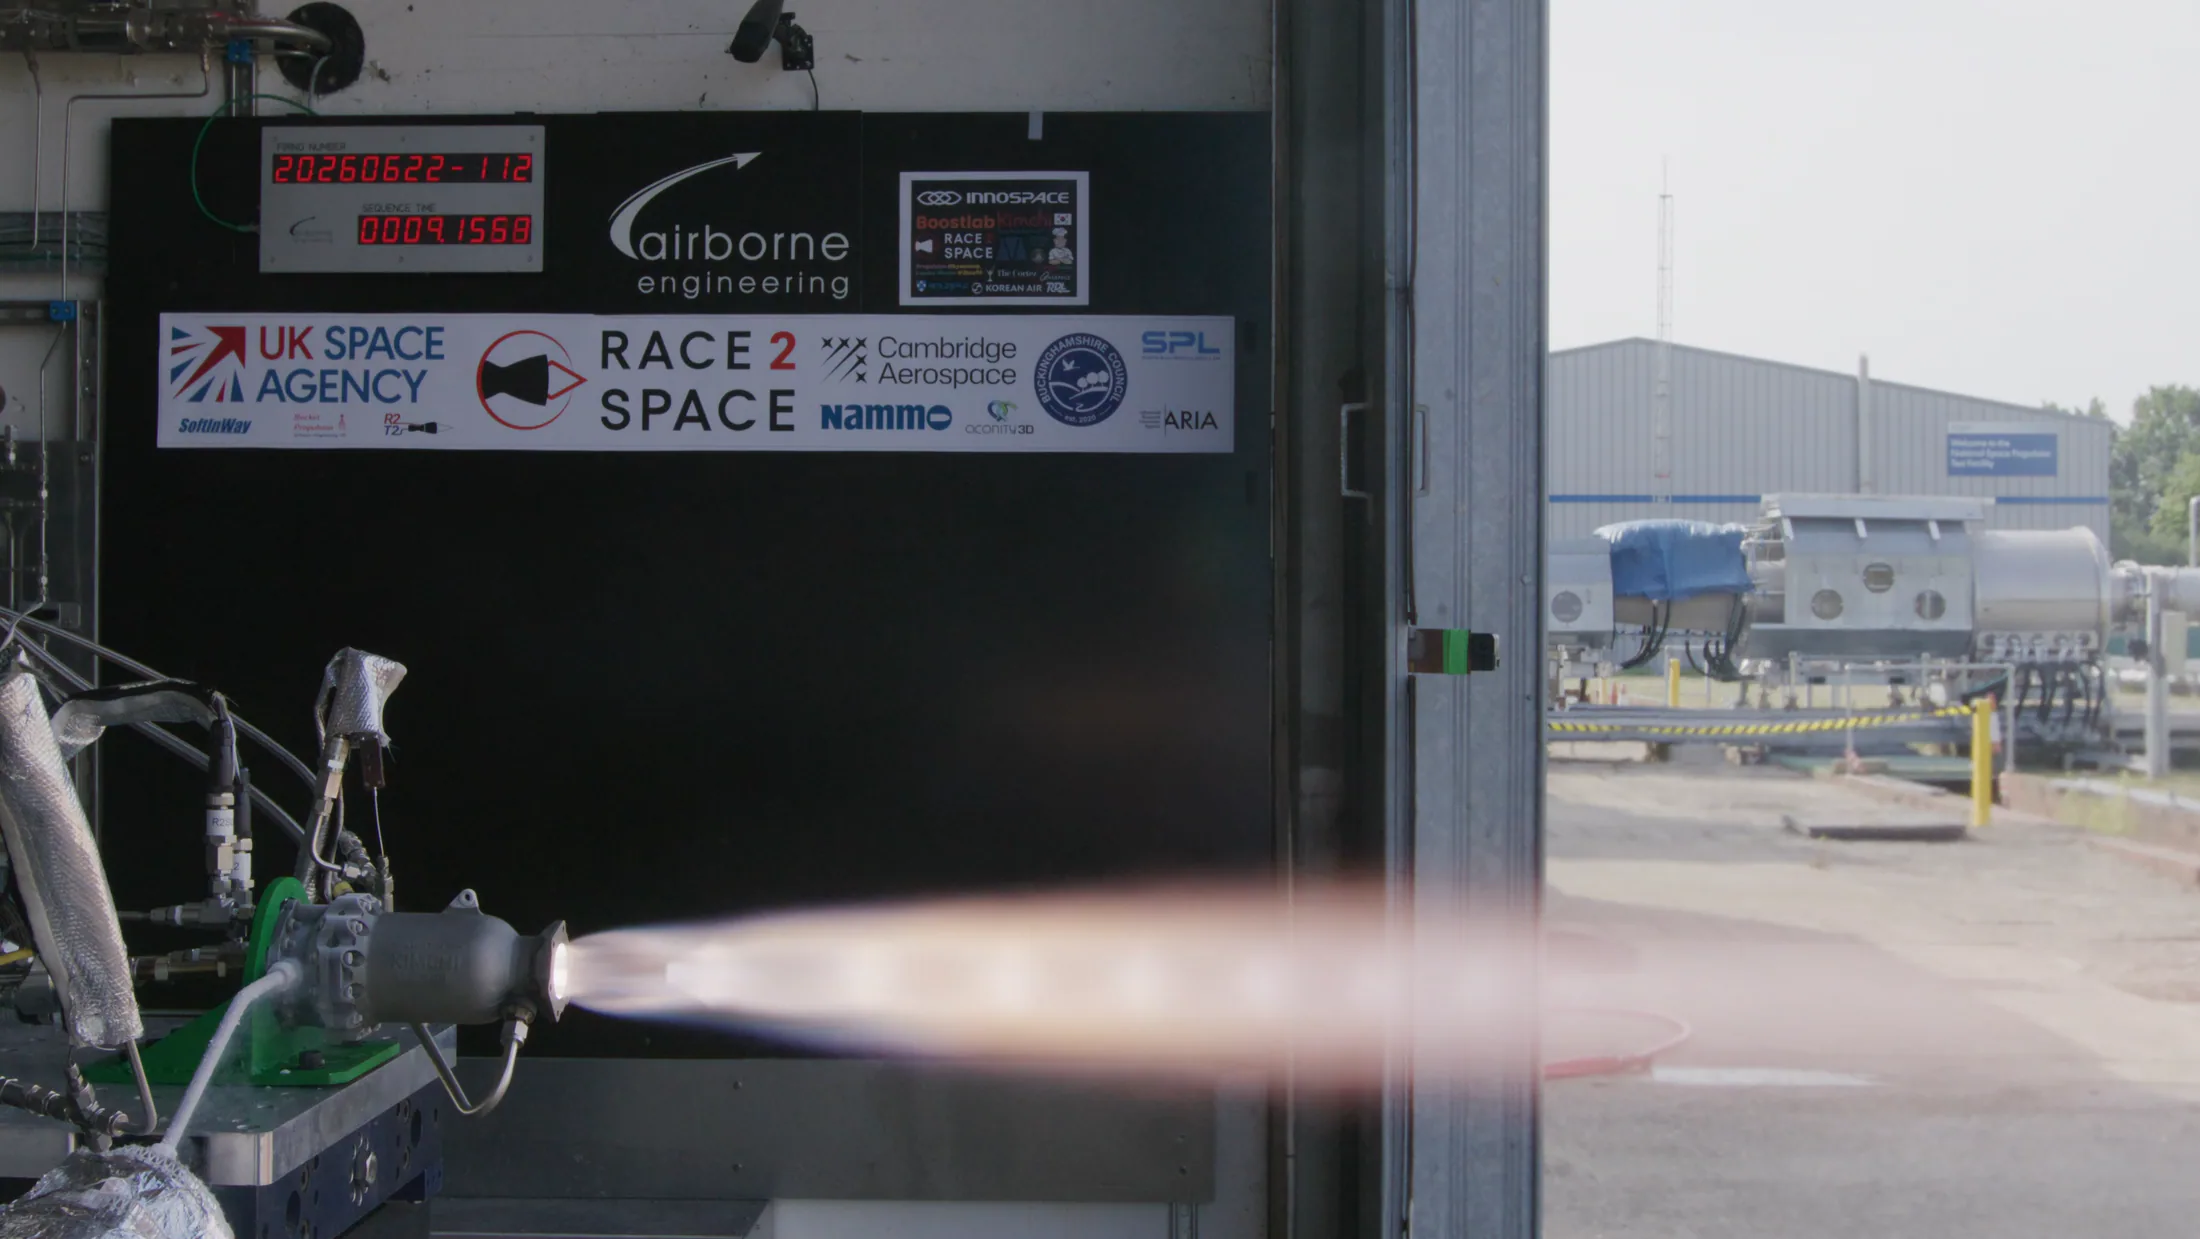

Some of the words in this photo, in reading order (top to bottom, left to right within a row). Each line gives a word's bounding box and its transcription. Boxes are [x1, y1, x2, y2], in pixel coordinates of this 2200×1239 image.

[309, 142, 346, 151] NUMBER
[363, 203, 411, 212] SEQUENCE
[416, 203, 436, 212] TIME
[916, 214, 995, 229] Boostlab
[639, 224, 850, 261] airborne
[944, 233, 982, 244] RACE
[944, 248, 993, 259] SPACE
[637, 271, 850, 300] engineering
[985, 284, 1024, 293] KOREAN
[1026, 284, 1043, 293] AIR
[259, 326, 314, 360] UK
[324, 325, 445, 361] SPACE
[602, 331, 751, 370] RACE
[769, 331, 796, 370] 2
[877, 336, 1017, 364] Cambridge
[1141, 331, 1221, 354] SPL
[877, 363, 1017, 388] Aerospace
[1037, 336, 1109, 403] BUCKINGHAMSHIRE
[1107, 352, 1125, 402] COUNCIL
[255, 368, 428, 404] AGENCY
[384, 413, 401, 425] R2
[601, 389, 795, 431] SPACE
[1165, 410, 1218, 430] ARIA
[384, 425, 401, 436] T2
